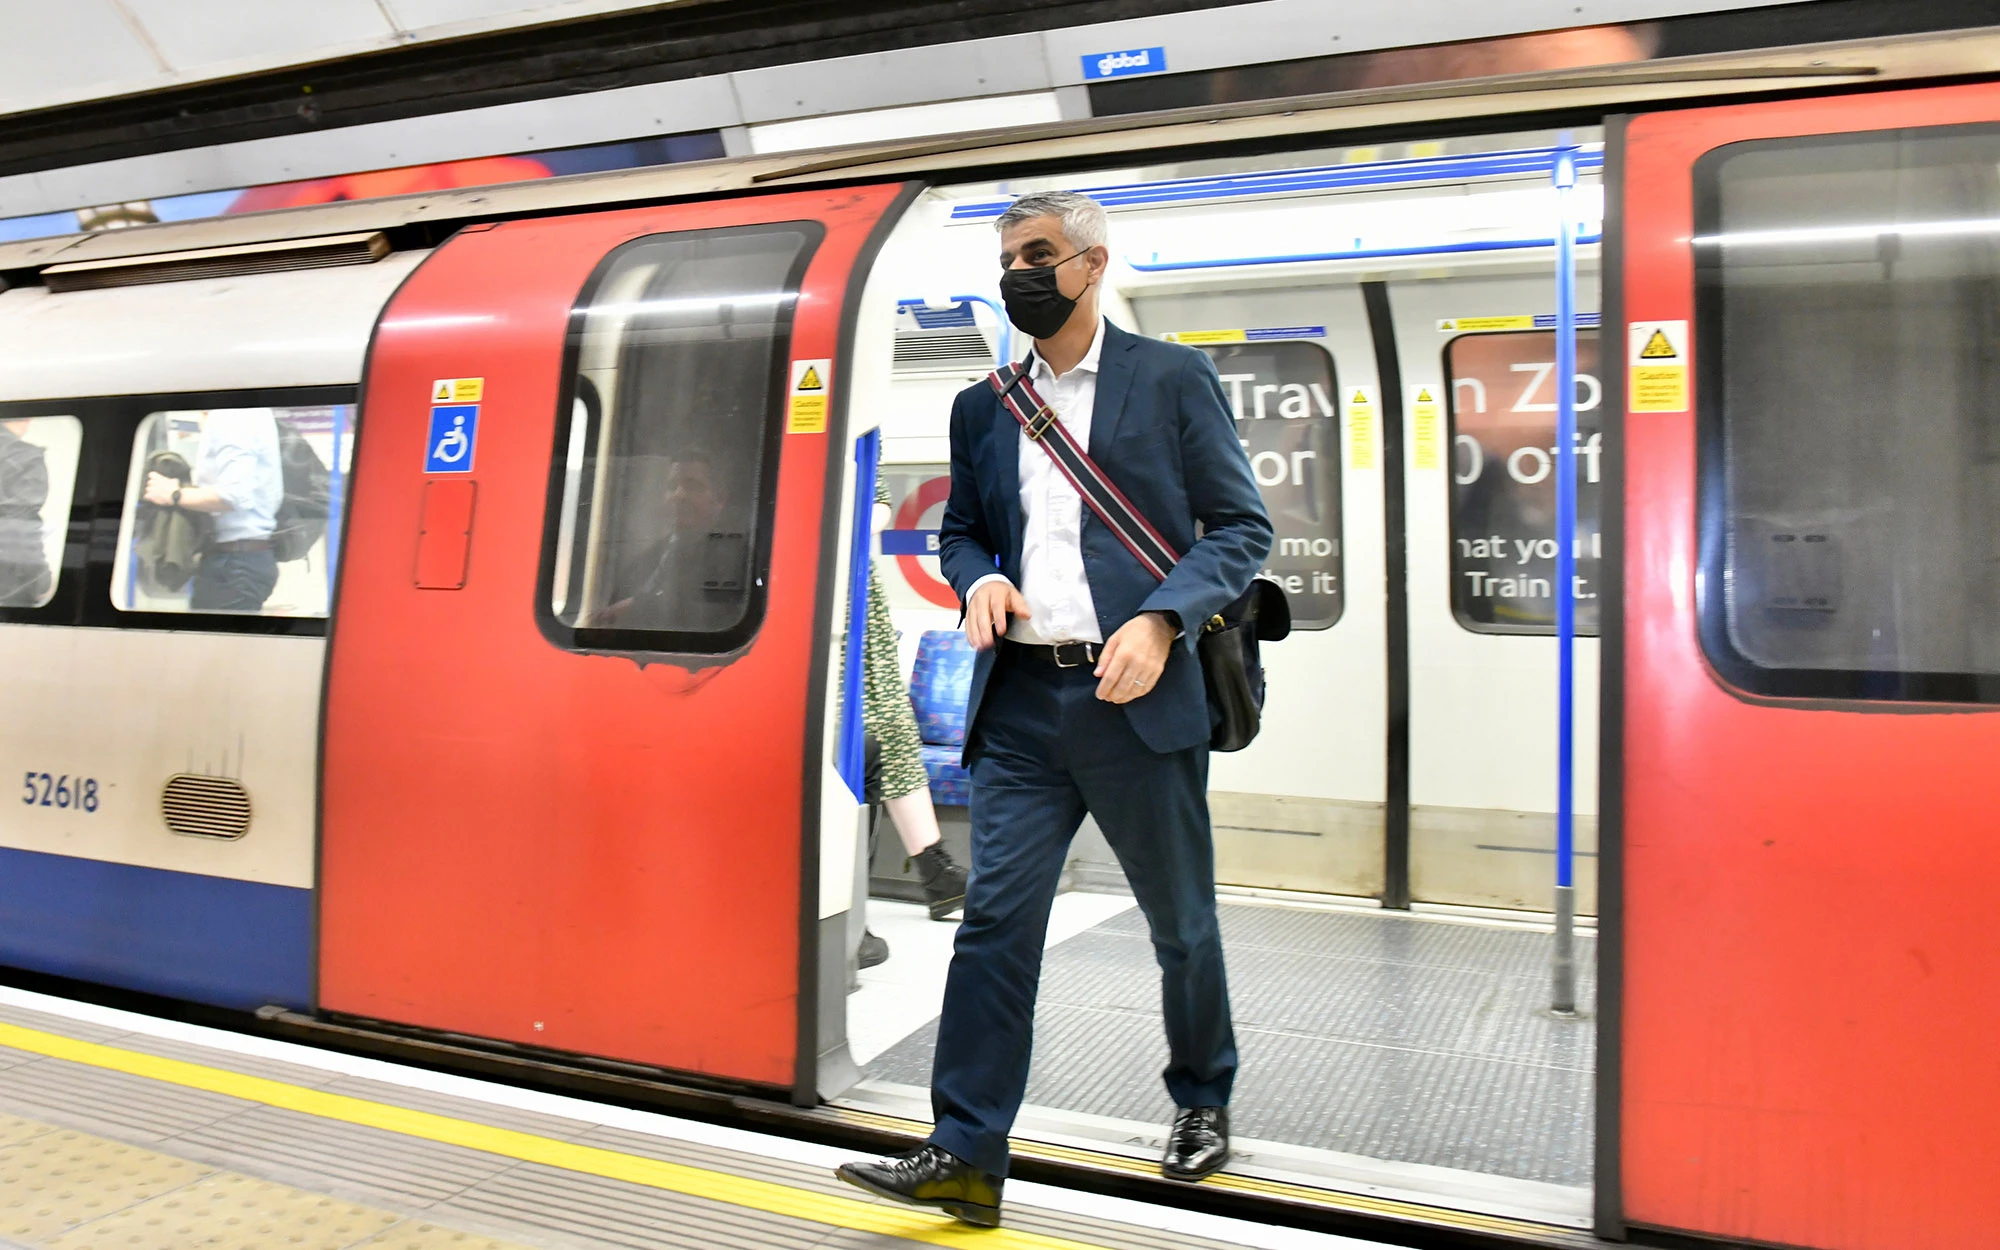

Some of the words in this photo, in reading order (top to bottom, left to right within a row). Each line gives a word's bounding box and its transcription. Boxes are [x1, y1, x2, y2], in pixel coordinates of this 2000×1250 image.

[1097, 50, 1150, 76] global
[1312, 571, 1337, 594] it
[1464, 571, 1550, 598] Train
[22, 771, 99, 813] 52618
